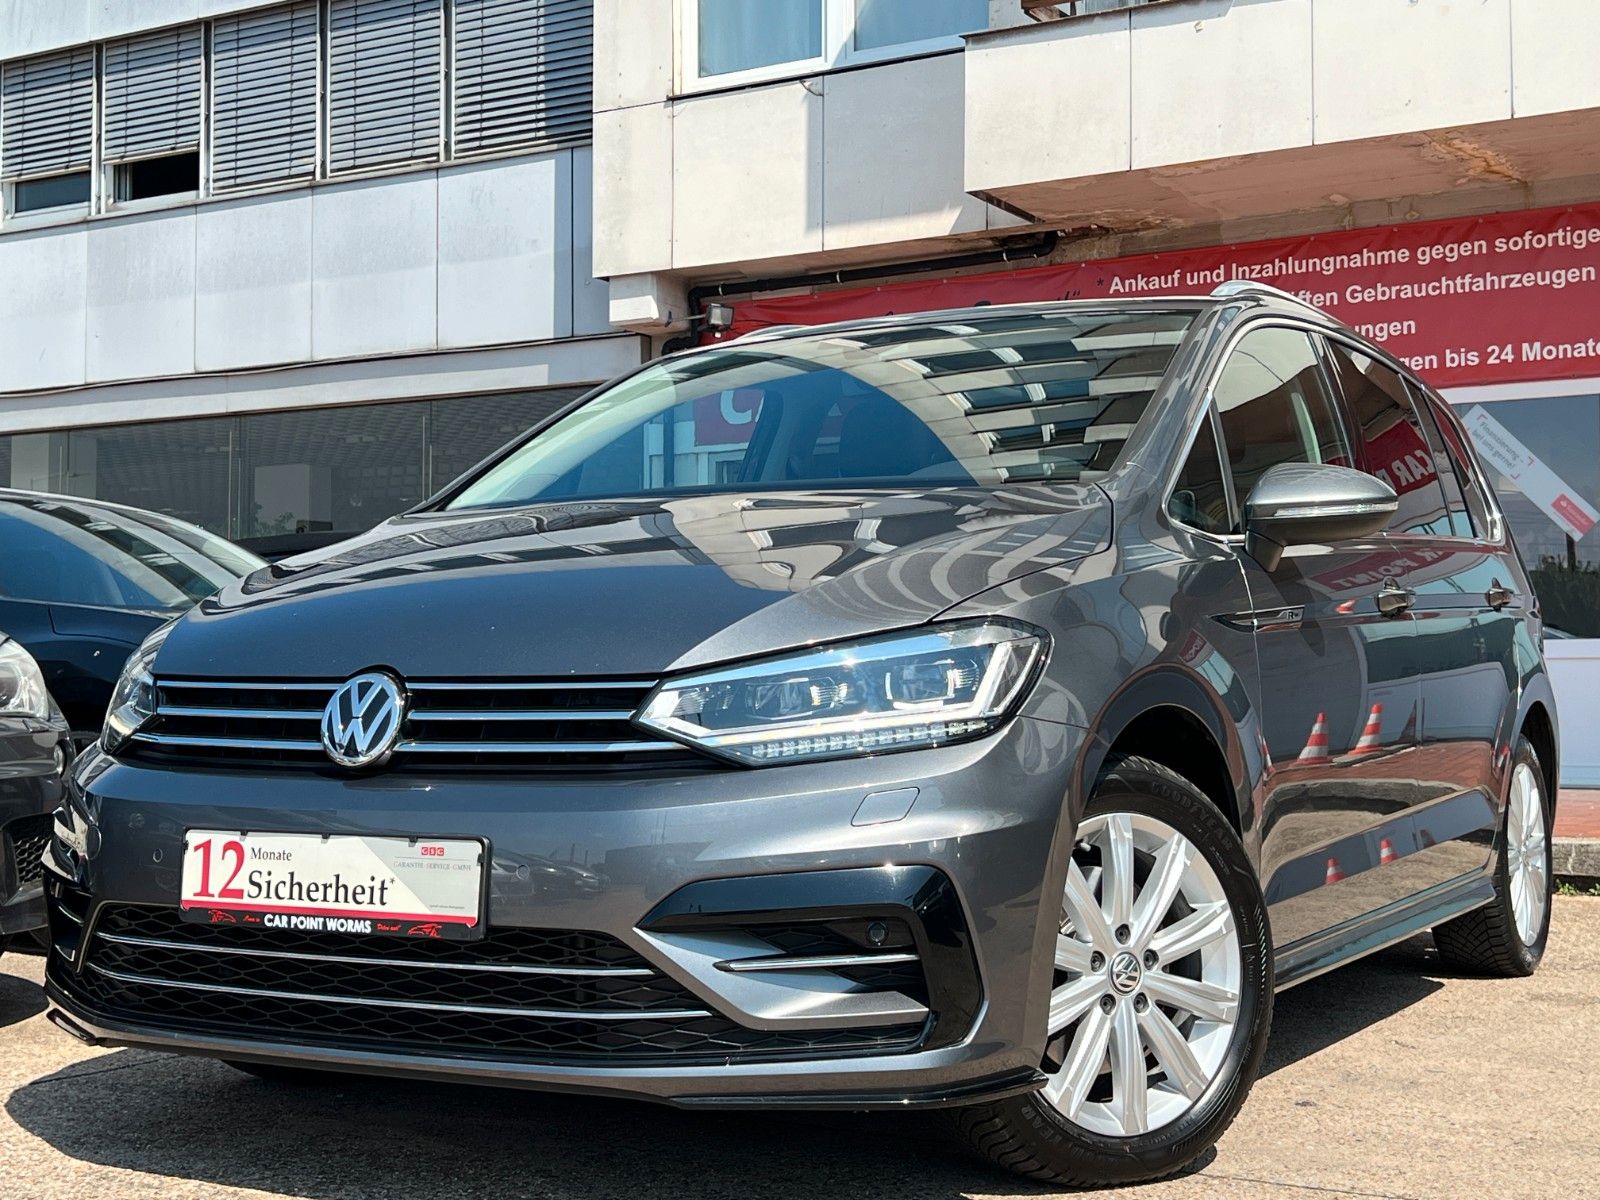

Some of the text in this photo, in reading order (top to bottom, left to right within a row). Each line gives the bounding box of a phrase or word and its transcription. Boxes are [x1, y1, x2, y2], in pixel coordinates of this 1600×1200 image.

[1109, 226, 1600, 294] Ankauf und Inzahlungnahme gegen sofortige
[1291, 266, 1596, 307] ften Gebrauchtfahrzeugen
[1355, 320, 1416, 342] ngen
[1445, 349, 1479, 368] bis
[1486, 344, 1513, 364] 24
[250, 847, 292, 861] Monate
[193, 838, 245, 899] 12
[264, 914, 288, 929] CAR
[291, 916, 325, 931] POINT
[326, 918, 371, 934] WORMS
